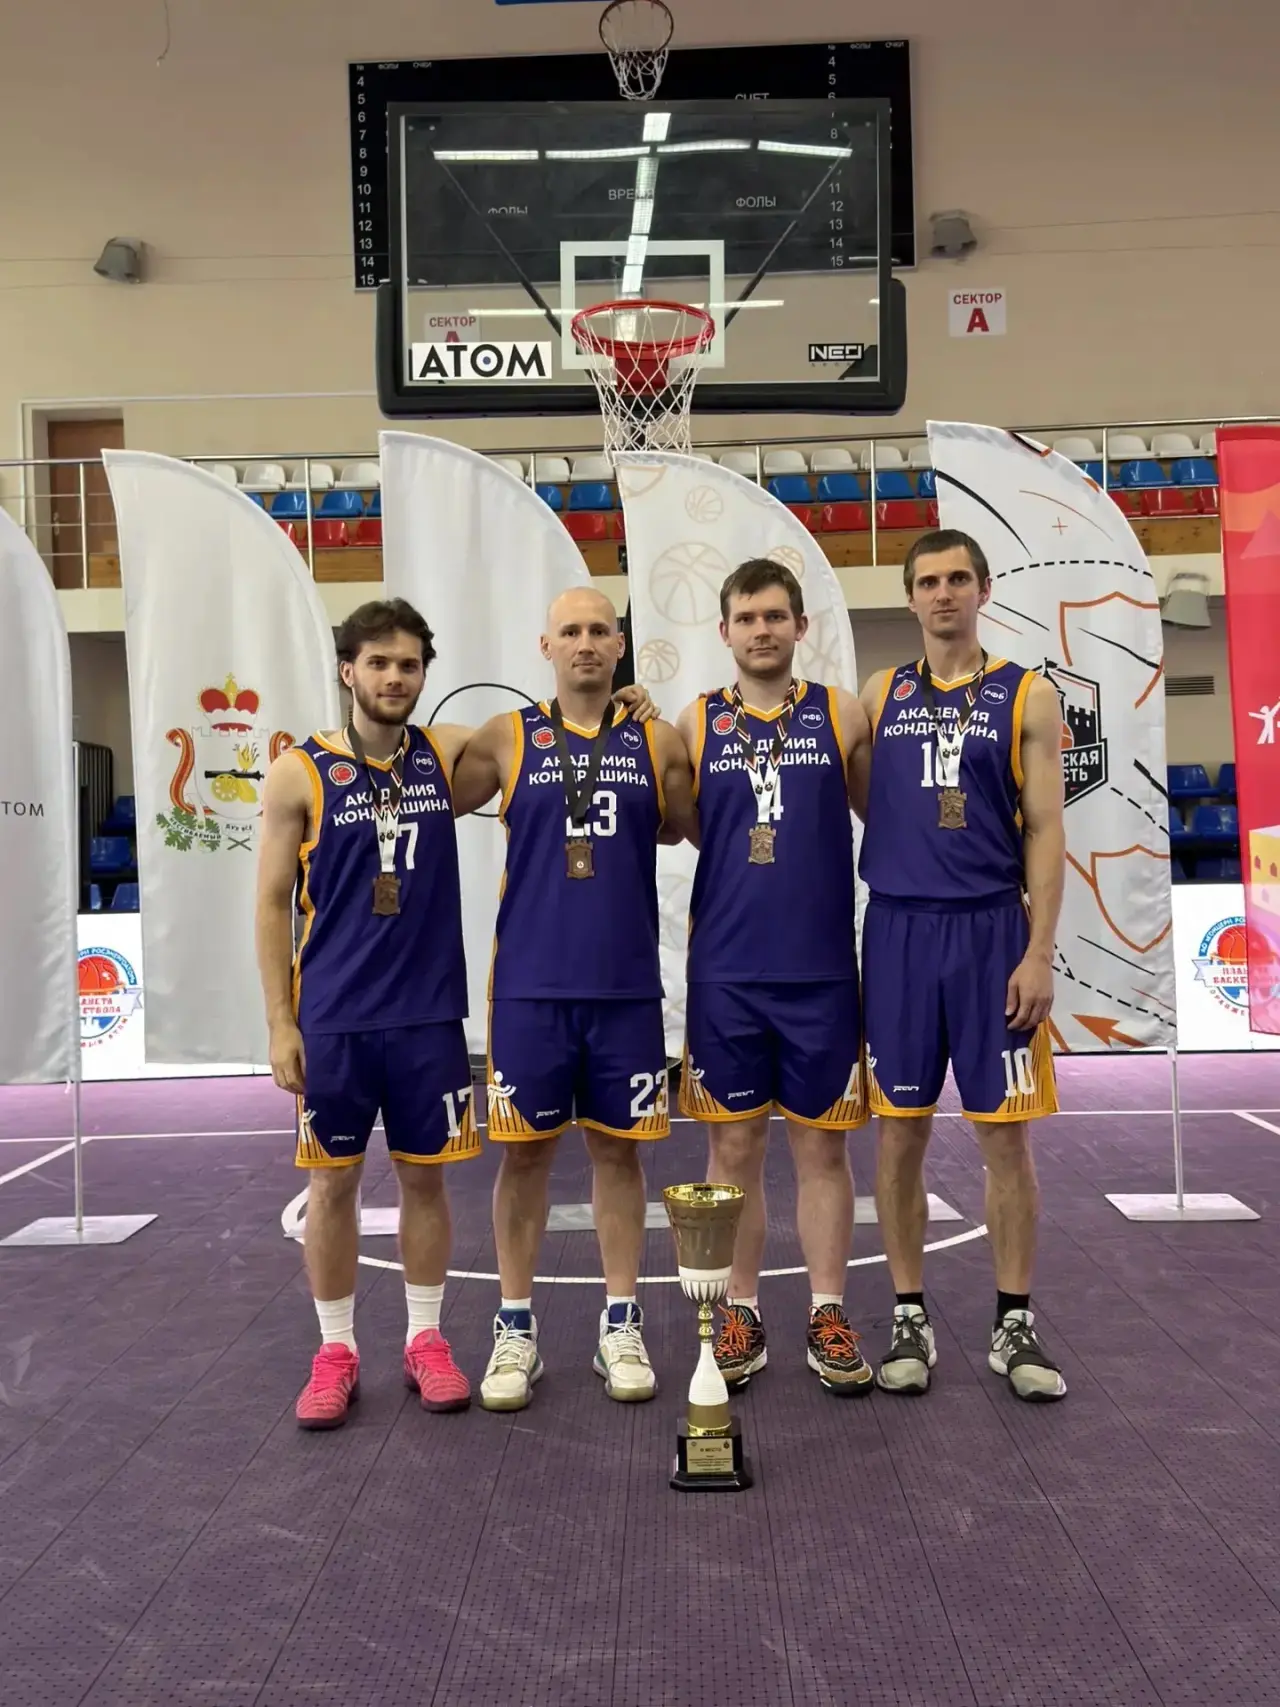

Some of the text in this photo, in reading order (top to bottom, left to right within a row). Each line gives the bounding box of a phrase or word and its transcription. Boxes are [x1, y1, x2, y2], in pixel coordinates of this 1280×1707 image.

[828, 56, 836, 67] 4
[357, 76, 364, 87] 4
[828, 74, 836, 85] 5
[357, 94, 366, 105] 5
[358, 112, 366, 122] 6
[359, 130, 366, 140] 7
[830, 128, 838, 139] 8
[359, 148, 367, 158] 8
[359, 166, 368, 177] 9
[357, 184, 371, 195] 10
[829, 183, 841, 193] 11
[736, 196, 777, 208] ФОЛЫ
[831, 201, 844, 212] 12
[359, 203, 371, 213] 11
[358, 221, 372, 231] 12
[829, 219, 843, 230] 13
[359, 238, 373, 249] 13
[829, 238, 843, 248] 14
[361, 257, 375, 267] 14
[831, 256, 844, 267] 15
[360, 275, 375, 285] 15
[953, 293, 1002, 304] СЕКТОР
[429, 316, 476, 328] СЕКТОР
[966, 308, 989, 332] А
[810, 344, 862, 360] NEO
[802, 713, 822, 721] РФБ
[529, 769, 648, 787] КОНРШИНА
[397, 822, 418, 870] 7
[1001, 1047, 1035, 1097] 10
[630, 1068, 668, 1118] 23
[442, 1085, 477, 1138] 17
